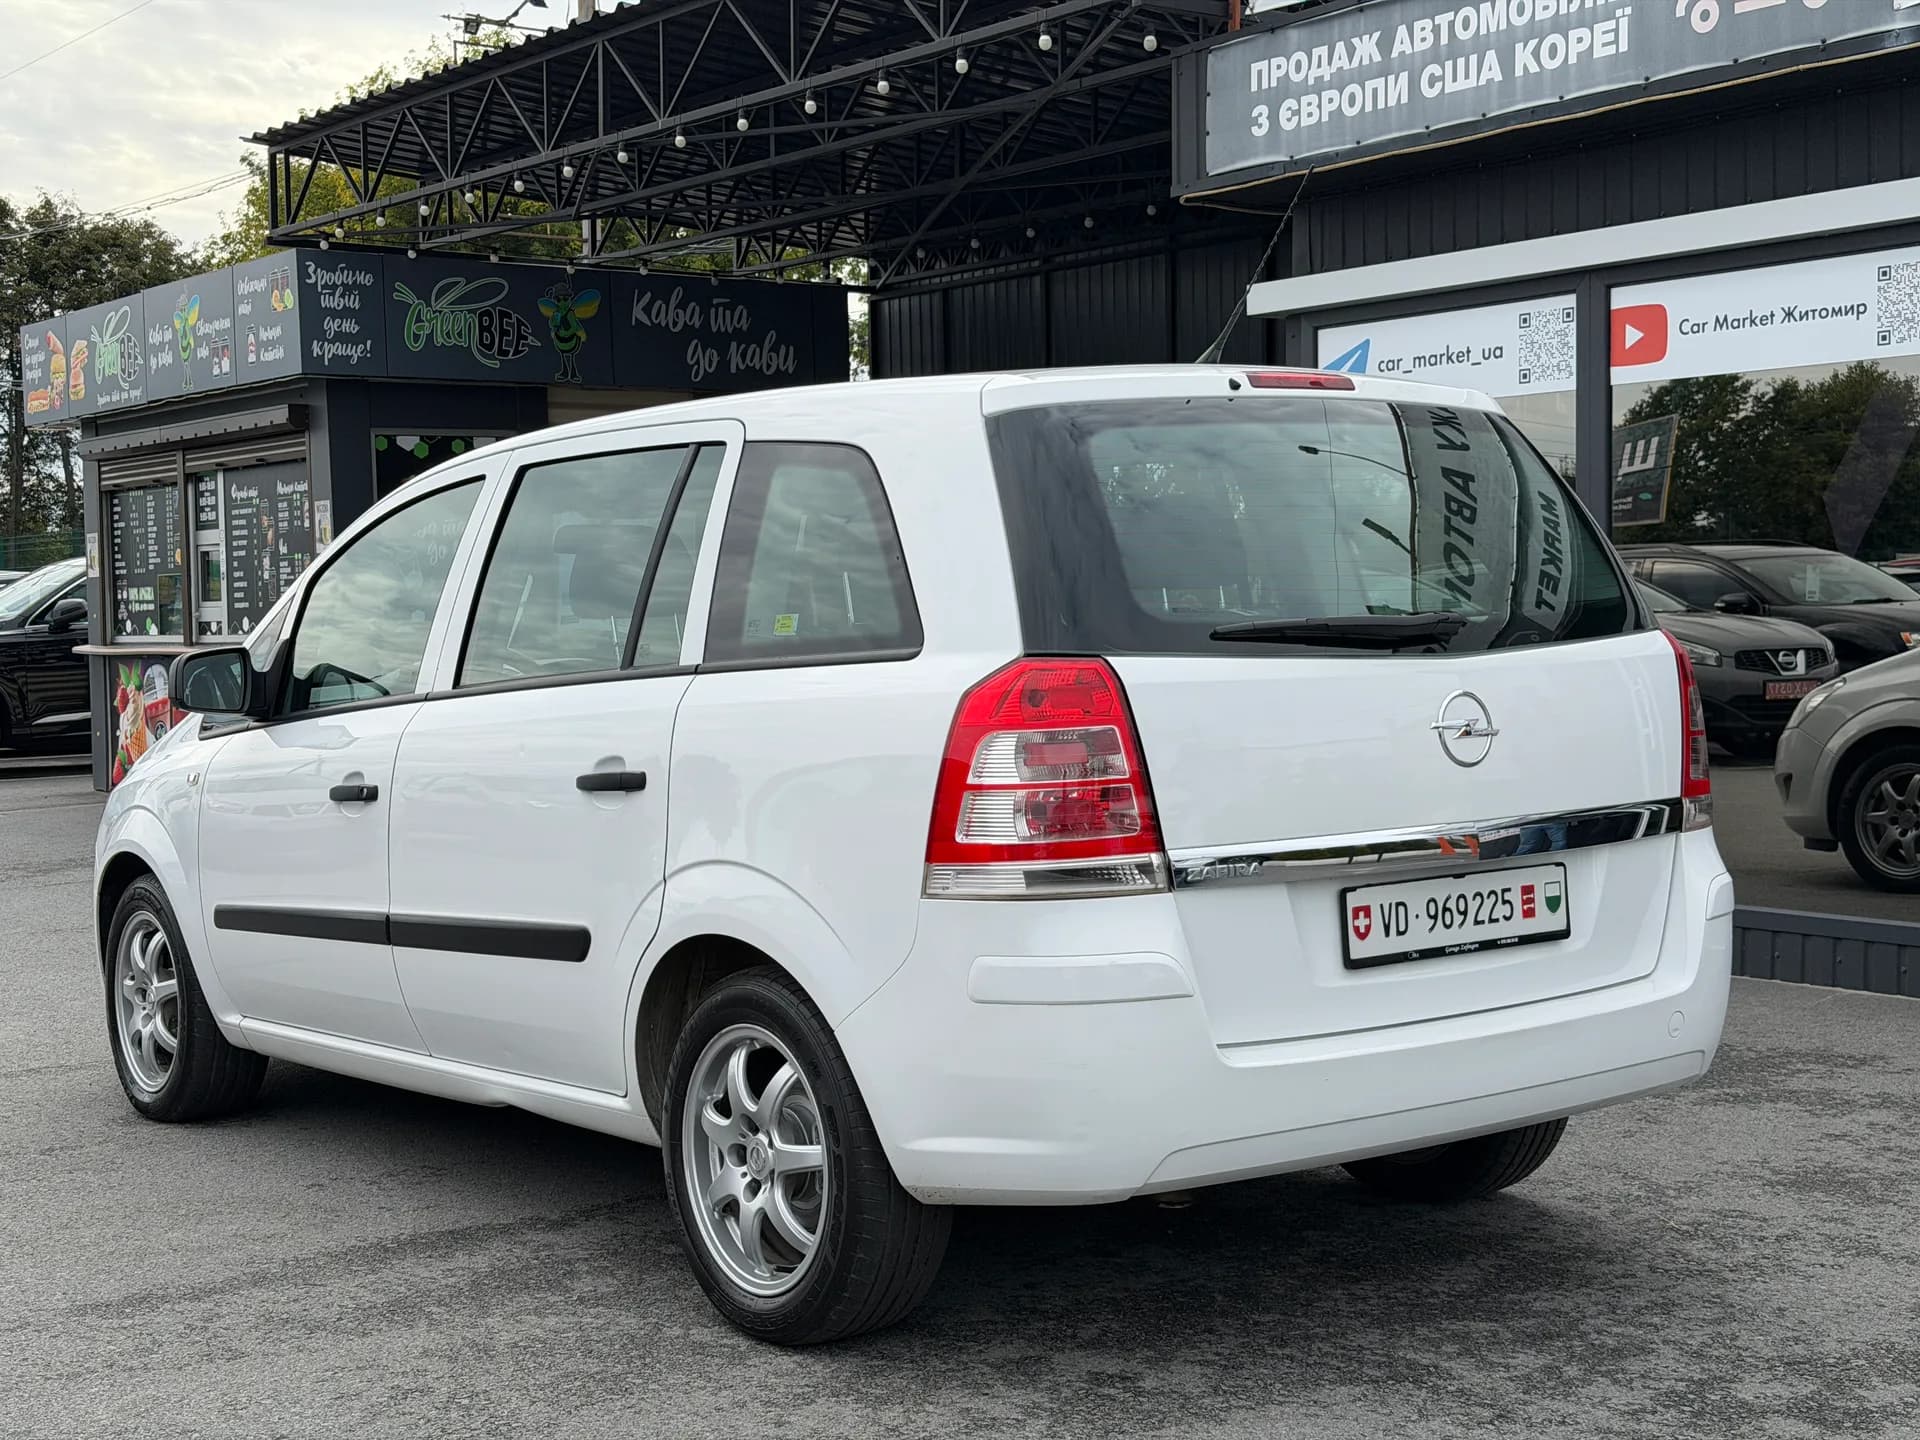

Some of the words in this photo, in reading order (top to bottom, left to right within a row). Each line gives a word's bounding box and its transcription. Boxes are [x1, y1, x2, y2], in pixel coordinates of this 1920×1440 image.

[1250, 30, 1383, 93] ПРОДАЖ
[1390, 0, 1617, 59] АВТОМОБ
[1250, 104, 1270, 137] З
[1278, 70, 1409, 131] ЄВРОПИ
[1419, 49, 1504, 99] США
[1514, 6, 1633, 78] КОРЕЇ
[305, 261, 375, 292] Зробимо
[320, 285, 361, 311] твій
[631, 285, 704, 334] Кава
[710, 297, 752, 334] та
[323, 315, 360, 340] день
[1678, 317, 1709, 336] Car
[1712, 308, 1776, 333] Market
[1779, 302, 1869, 325] Житомир
[311, 339, 372, 366] краще!
[686, 338, 720, 383] до
[727, 329, 798, 376] кави
[1378, 343, 1504, 375] car_market_ua
[1186, 862, 1262, 882] ZAFIRA
